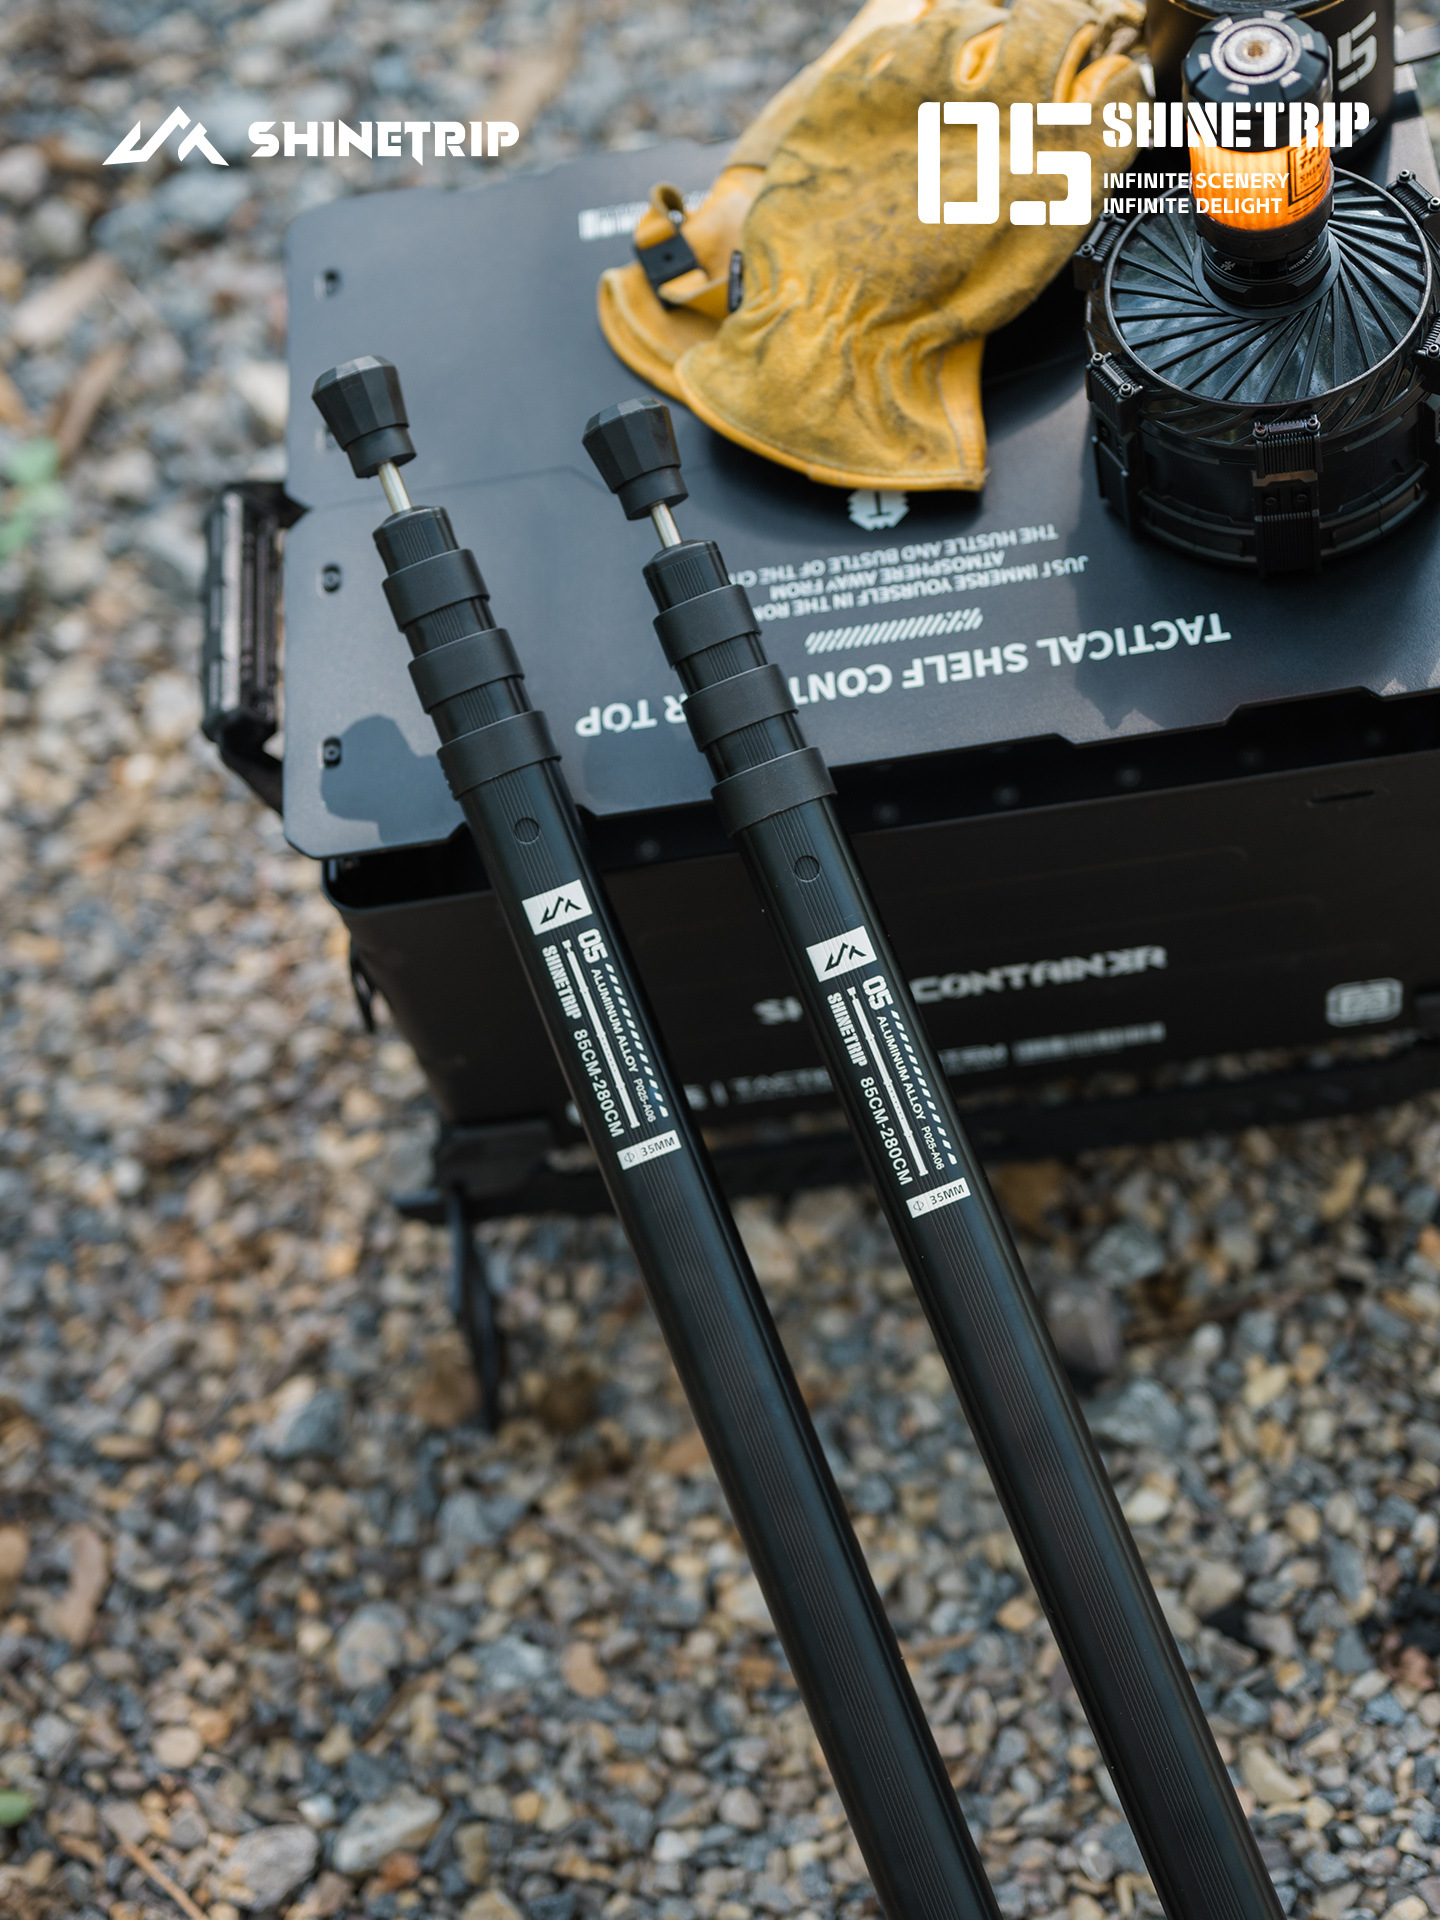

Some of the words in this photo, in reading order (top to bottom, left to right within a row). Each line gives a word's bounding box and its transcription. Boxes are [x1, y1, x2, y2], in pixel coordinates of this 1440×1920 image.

[948, 530, 1018, 555] HUSTLE
[1019, 523, 1059, 545] THE
[828, 547, 900, 572] BUSTLE
[879, 550, 1006, 577] ATMOSPHERE
[900, 540, 949, 563] AND
[758, 563, 796, 585] THE
[799, 560, 826, 578] OF
[953, 561, 1038, 592] IMMERSE
[1041, 555, 1089, 577] JUST
[769, 578, 825, 602] FROM
[826, 570, 878, 592] AWAY
[857, 575, 953, 606] YOURSELF
[793, 595, 831, 616] THE
[832, 590, 855, 611] IN
[1035, 612, 1232, 667] TACTICAL
[902, 642, 1029, 690] SHELF
[575, 698, 658, 738] TOP
[577, 928, 608, 964] 05
[862, 974, 894, 1011] 05
[590, 968, 624, 1034] ALUMINUM
[616, 1035, 639, 1073] ALLOY
[541, 944, 582, 1020] SHINETRIP
[573, 1028, 625, 1138] 85CM-280CM
[826, 991, 868, 1067] SHINETRIP
[860, 1076, 914, 1186] 85CM-280CM
[876, 1015, 910, 1082] ALUMINUM
[902, 1082, 927, 1120] ALLOY
[921, 1125, 945, 1171] P025-A06
[640, 1136, 676, 1157] 35MM
[929, 1184, 965, 1206] 35MM
